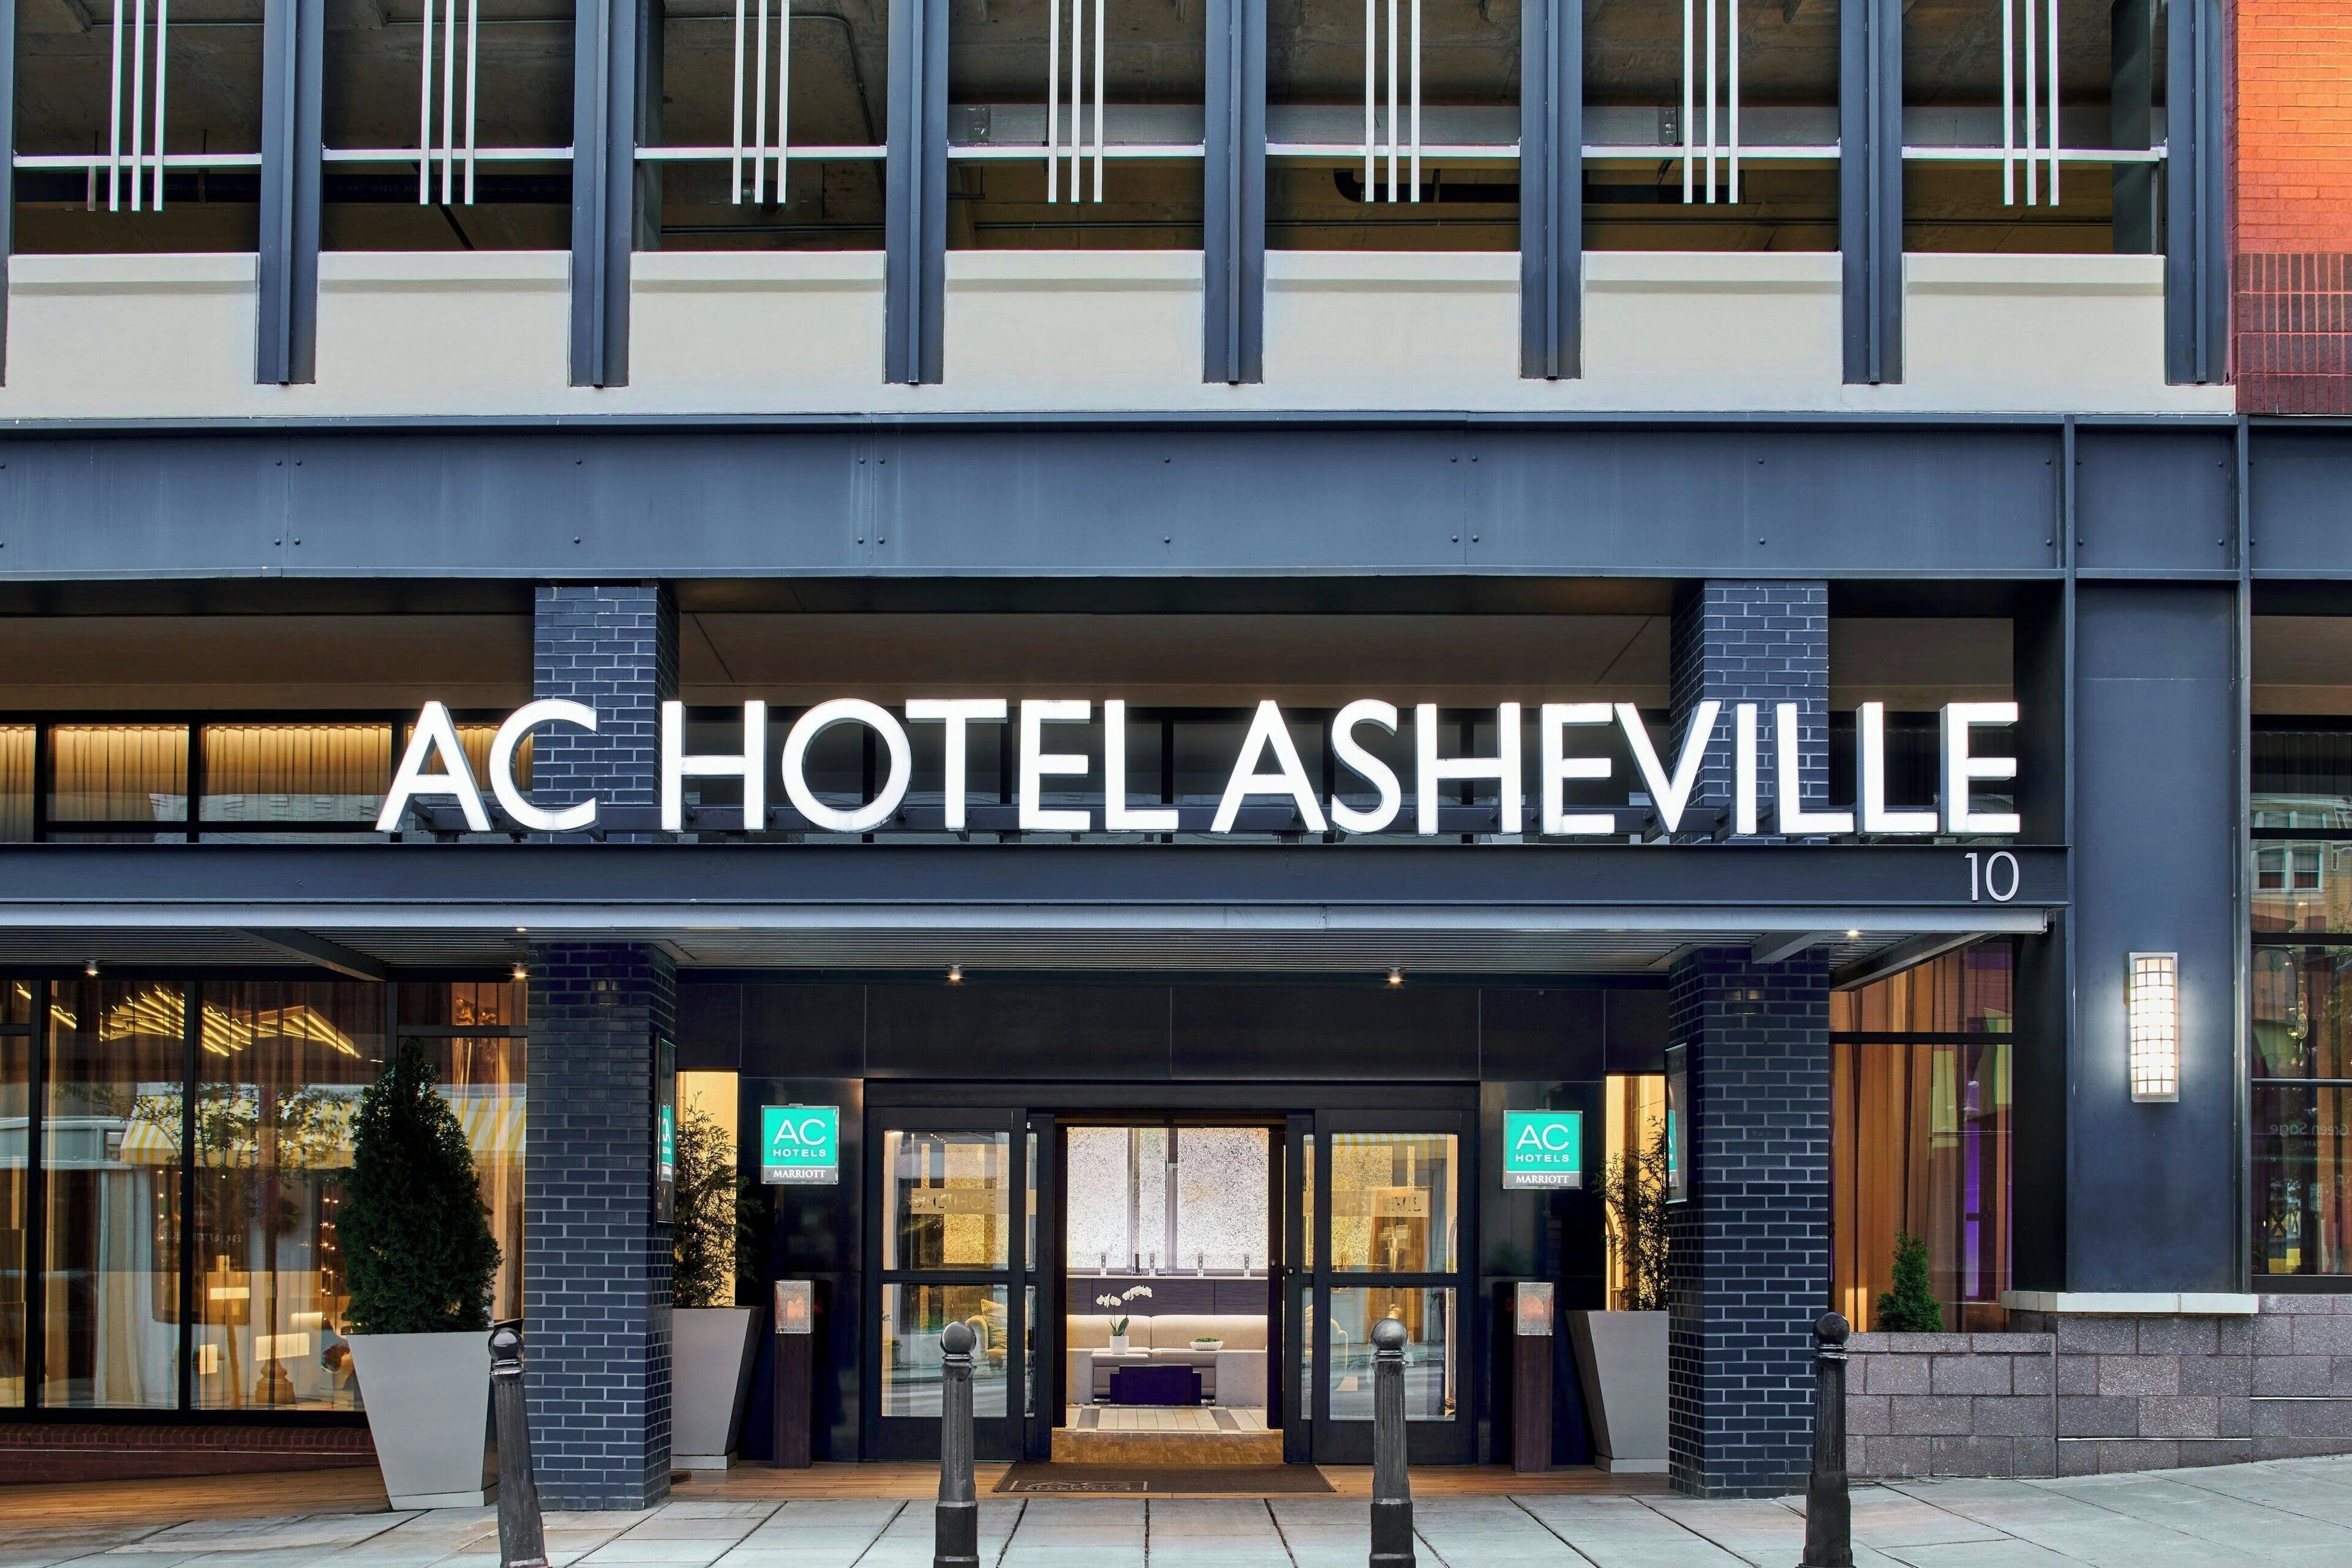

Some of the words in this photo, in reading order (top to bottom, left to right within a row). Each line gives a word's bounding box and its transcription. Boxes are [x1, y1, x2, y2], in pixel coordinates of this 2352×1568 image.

[375, 698, 599, 833] AC
[660, 698, 1180, 834] HOTEL
[1210, 699, 2021, 837] ASHEVILLE
[1964, 850, 2020, 902] 10
[773, 1118, 826, 1145] AC
[1515, 1123, 1570, 1151] AC
[772, 1148, 826, 1157] HOTELS
[1515, 1154, 1569, 1163] HOTELS
[773, 1169, 826, 1178] MARRIOTT
[1515, 1175, 1569, 1184] MARRIOTT
